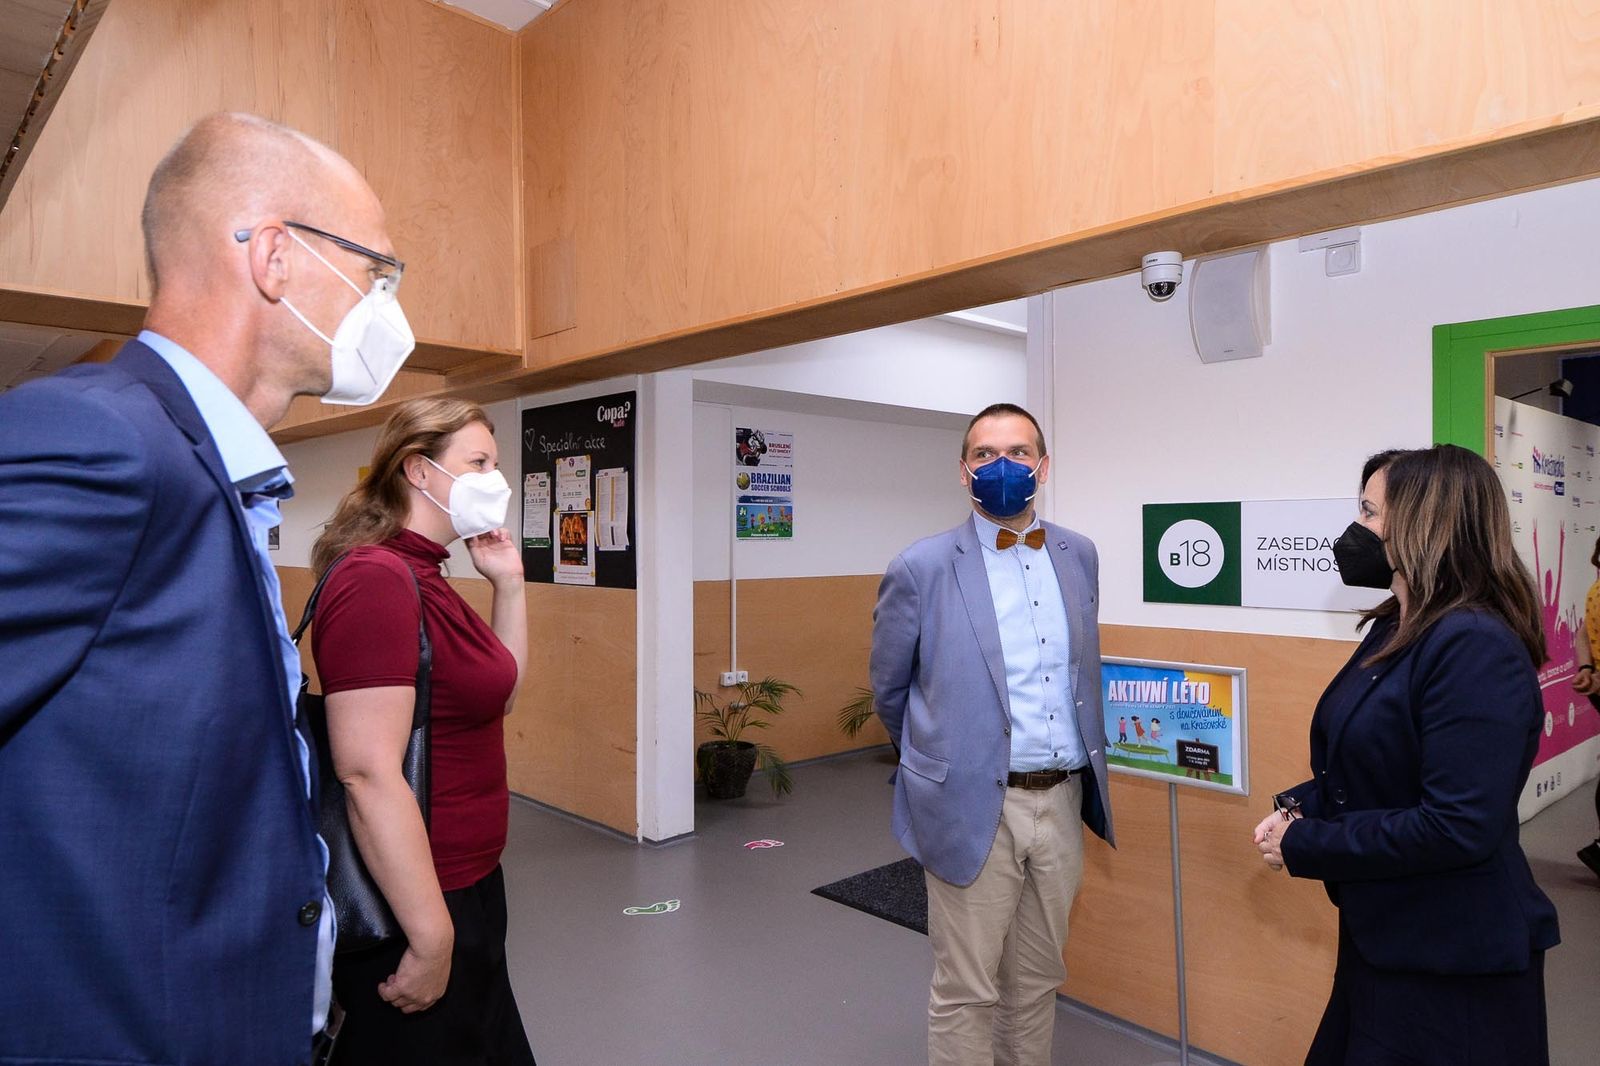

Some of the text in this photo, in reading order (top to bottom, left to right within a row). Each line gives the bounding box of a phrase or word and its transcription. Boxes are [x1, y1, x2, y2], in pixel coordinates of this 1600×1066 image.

[597, 401, 631, 424] Copa?
[751, 472, 791, 485] BRAZILIAN
[1170, 539, 1211, 567] B18
[1109, 677, 1211, 705] AKTIVNÍ LÉTO
[1169, 710, 1175, 720] s
[1180, 717, 1227, 730] na Krašovské
[1184, 745, 1211, 756] ZDARMA
